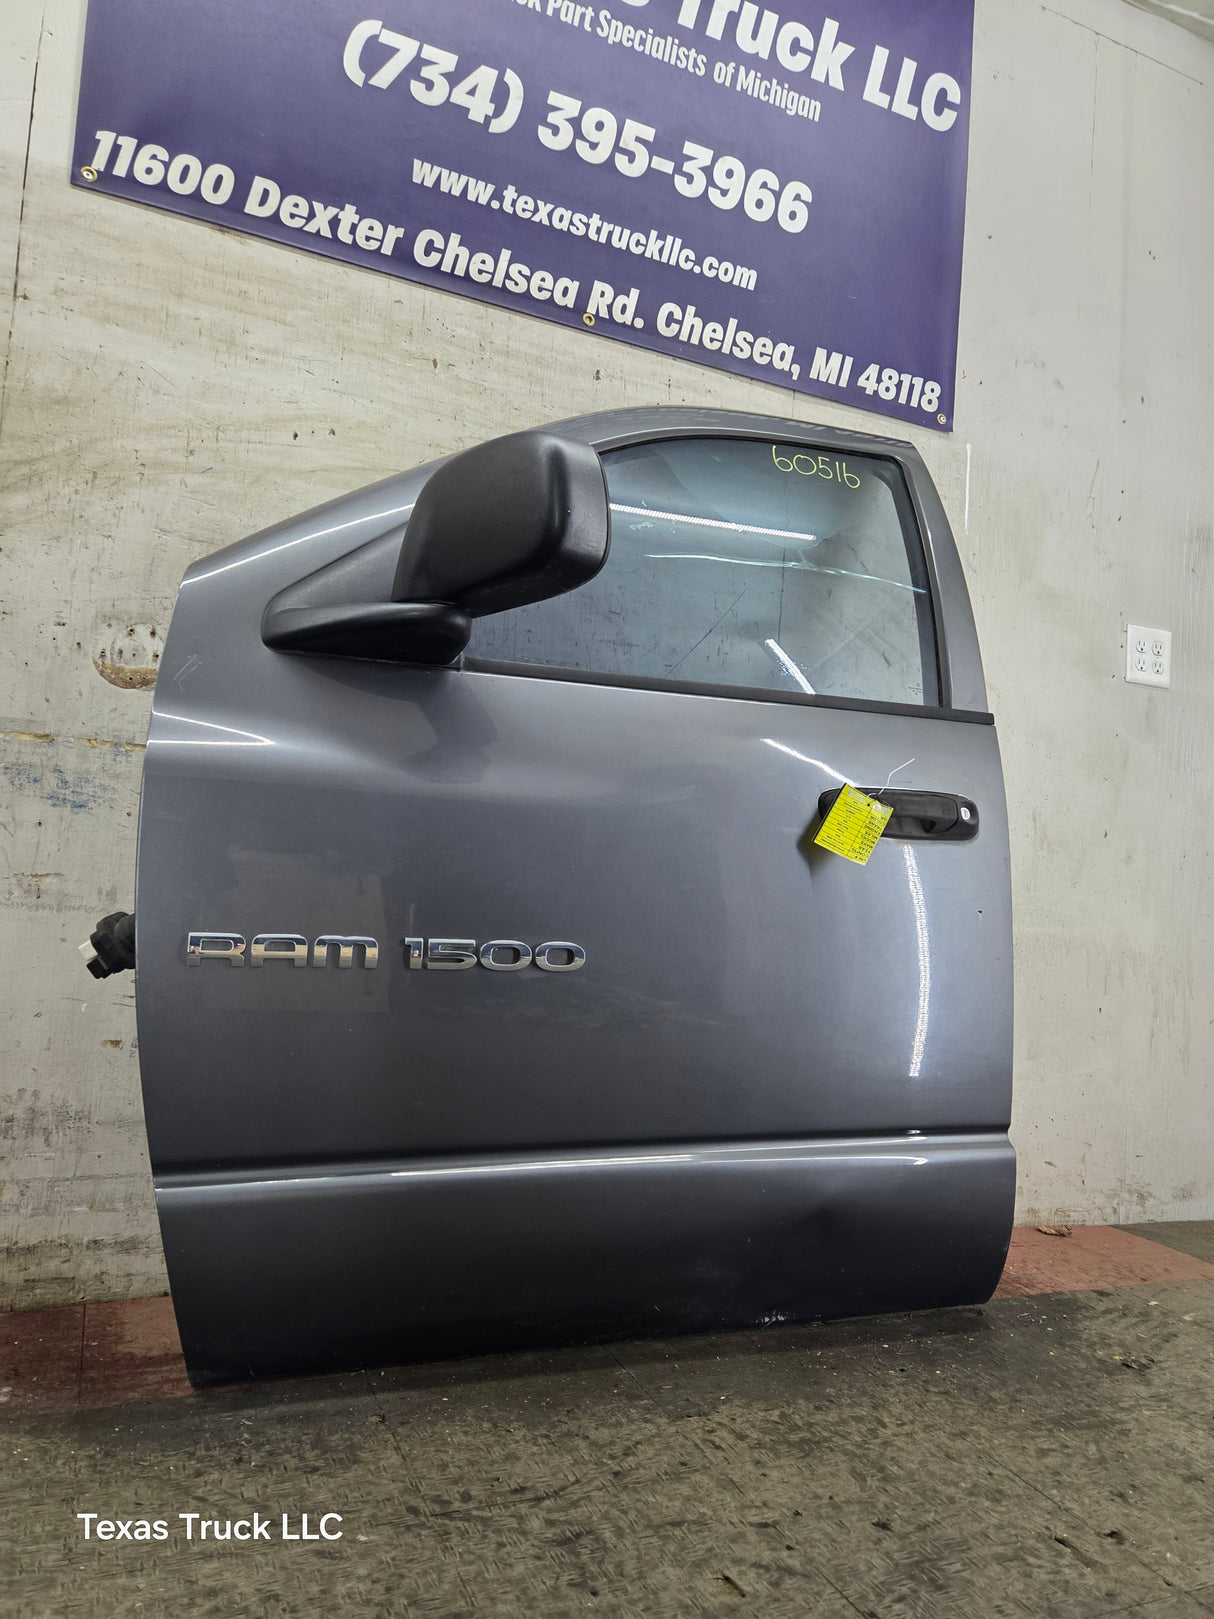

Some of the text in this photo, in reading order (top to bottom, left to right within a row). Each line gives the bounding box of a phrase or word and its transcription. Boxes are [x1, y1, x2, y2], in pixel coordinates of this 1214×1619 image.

[546, 0, 822, 123] Part Specialists of Michigan
[862, 44, 961, 132] LLC
[342, 18, 813, 234] (734) 395-3966
[90, 130, 942, 413] 11600 Dexter Chelsea Rd. Chelsea, MI 48118
[412, 158, 758, 291] www.texastruckllc.com
[772, 445, 861, 488] 60516
[186, 931, 587, 972] RAM 1500
